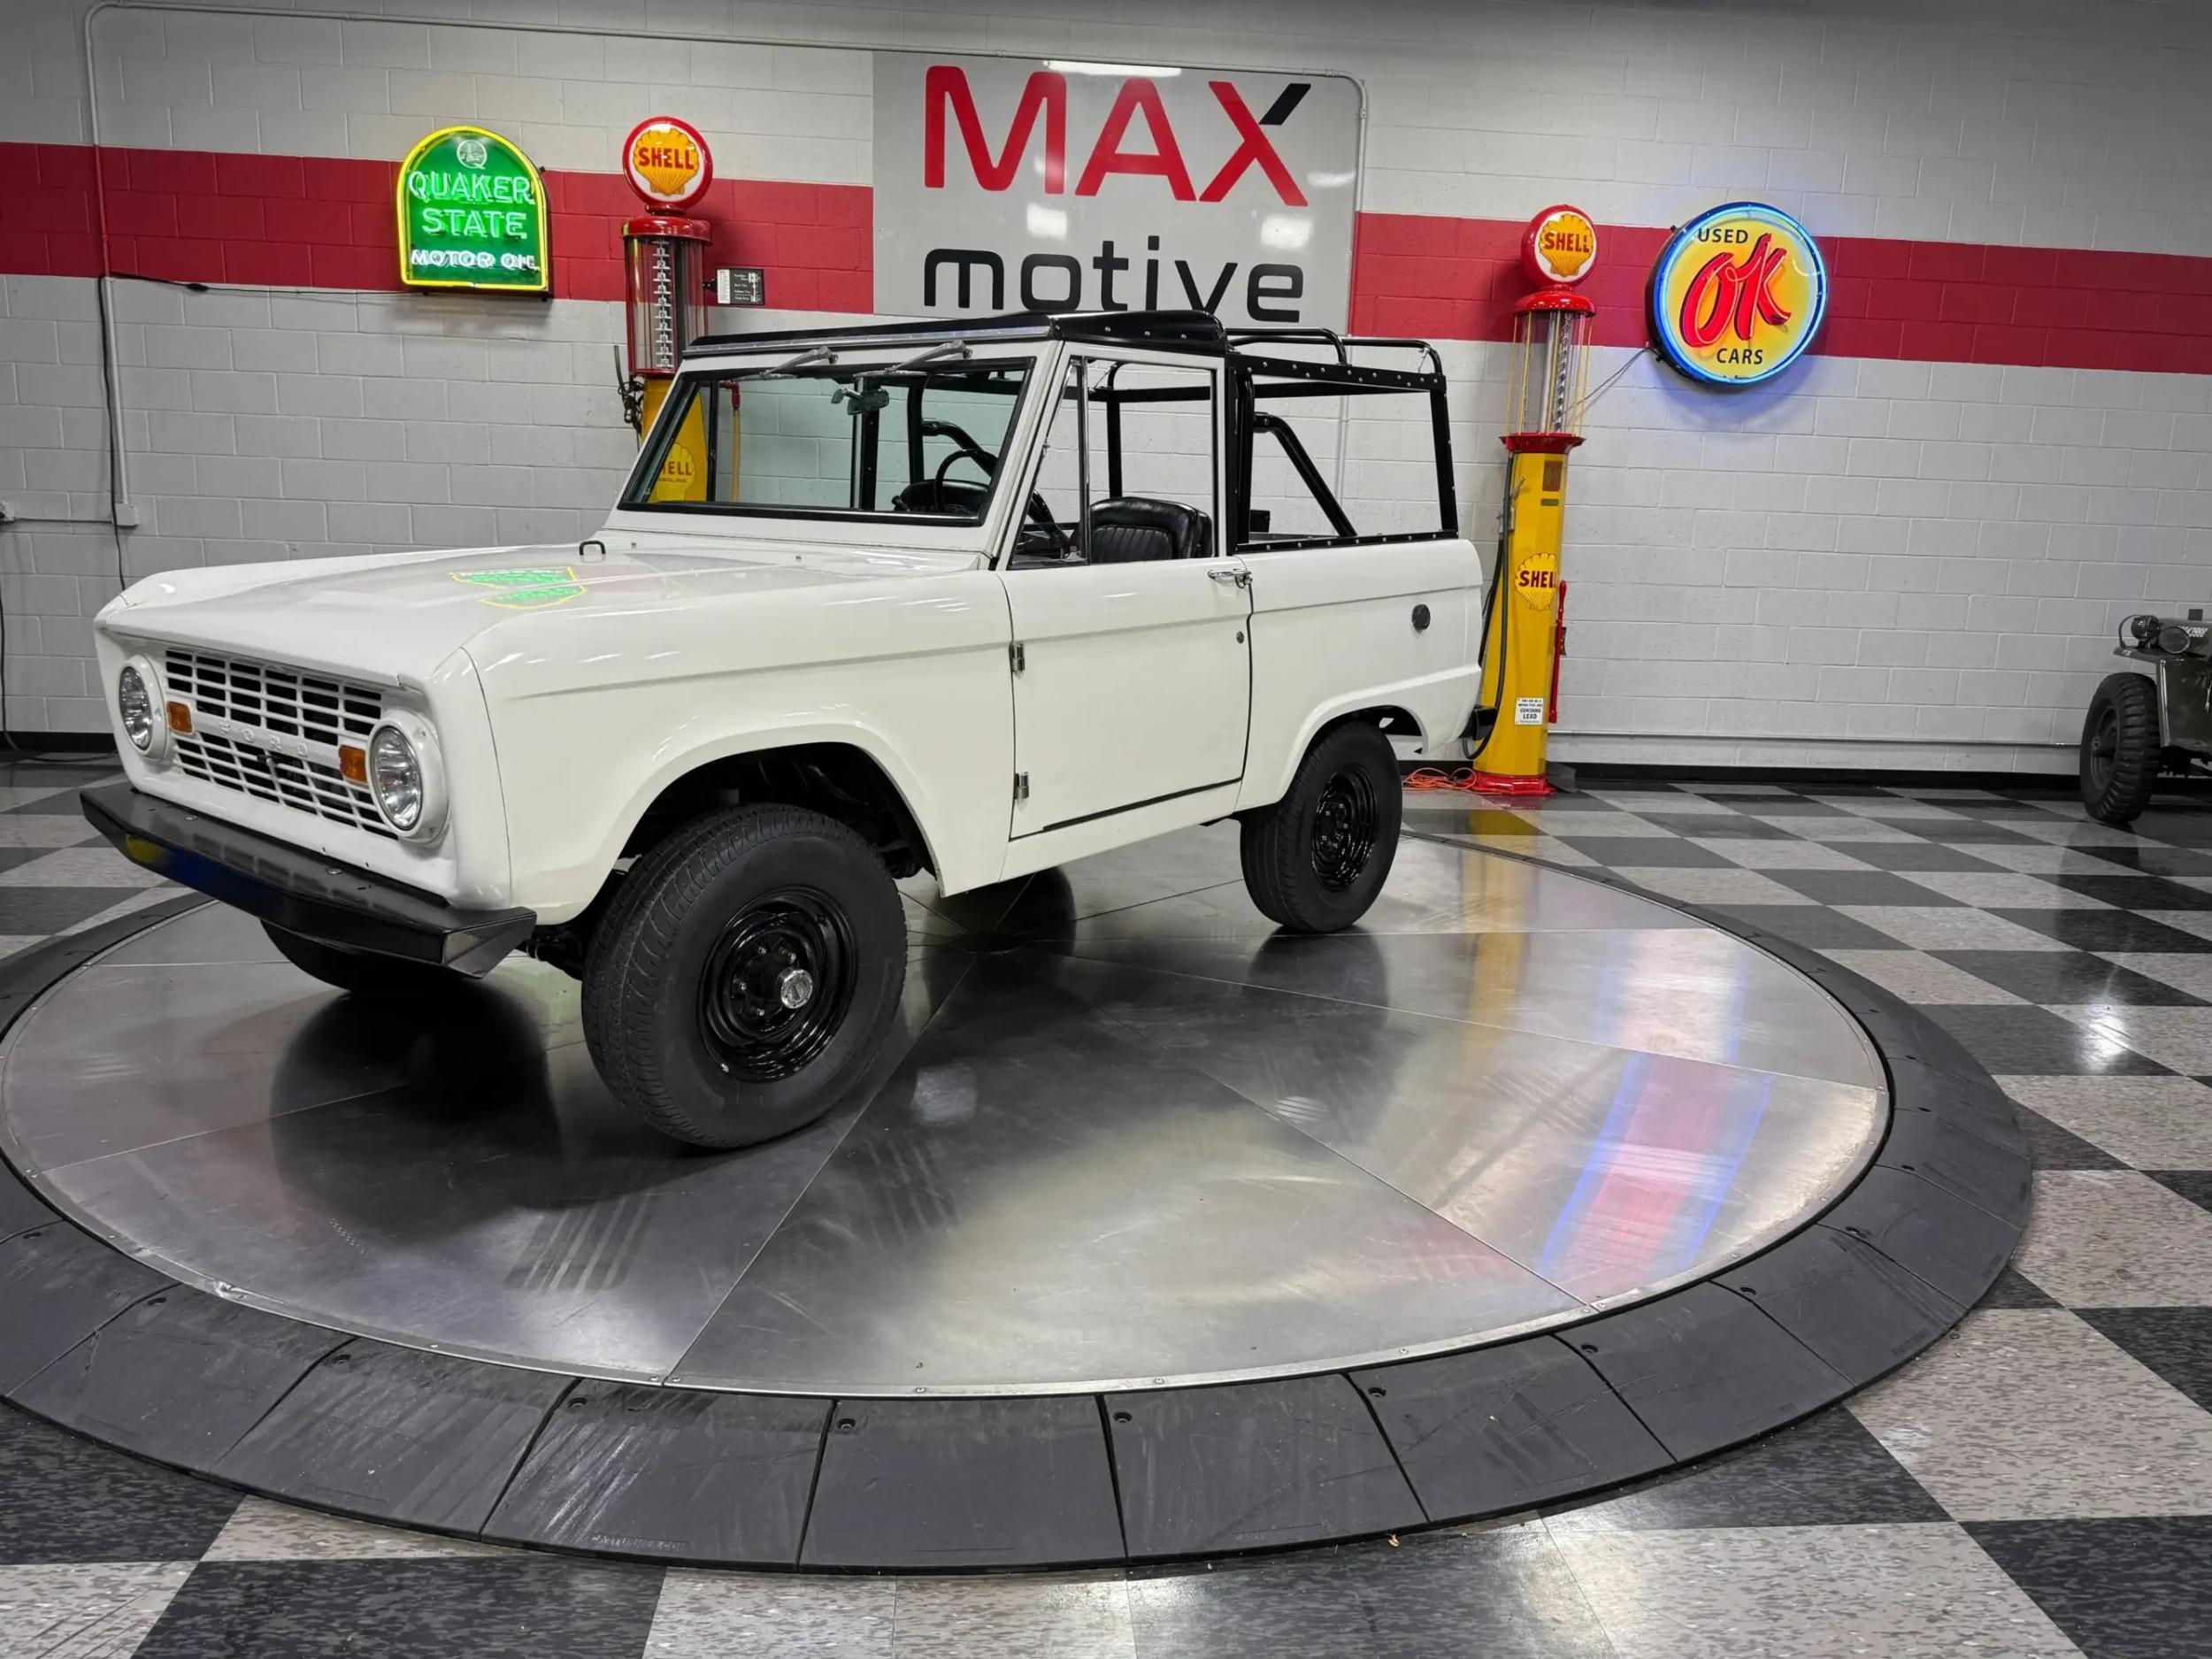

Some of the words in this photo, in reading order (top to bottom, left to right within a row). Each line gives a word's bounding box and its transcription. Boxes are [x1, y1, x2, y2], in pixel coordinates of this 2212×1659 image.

[924, 65, 1311, 207] MAX
[638, 146, 695, 171] SHELL
[408, 171, 536, 204] QUAKER
[422, 207, 527, 240] STATE
[1698, 228, 1748, 244] USED
[1544, 232, 1590, 254] SHELL
[411, 249, 496, 268] MOTOR
[501, 252, 541, 271] OIL
[923, 234, 1304, 323] motive
[1679, 233, 1792, 348] OK
[1717, 348, 1763, 365] CARS
[218, 720, 308, 758] FORD
